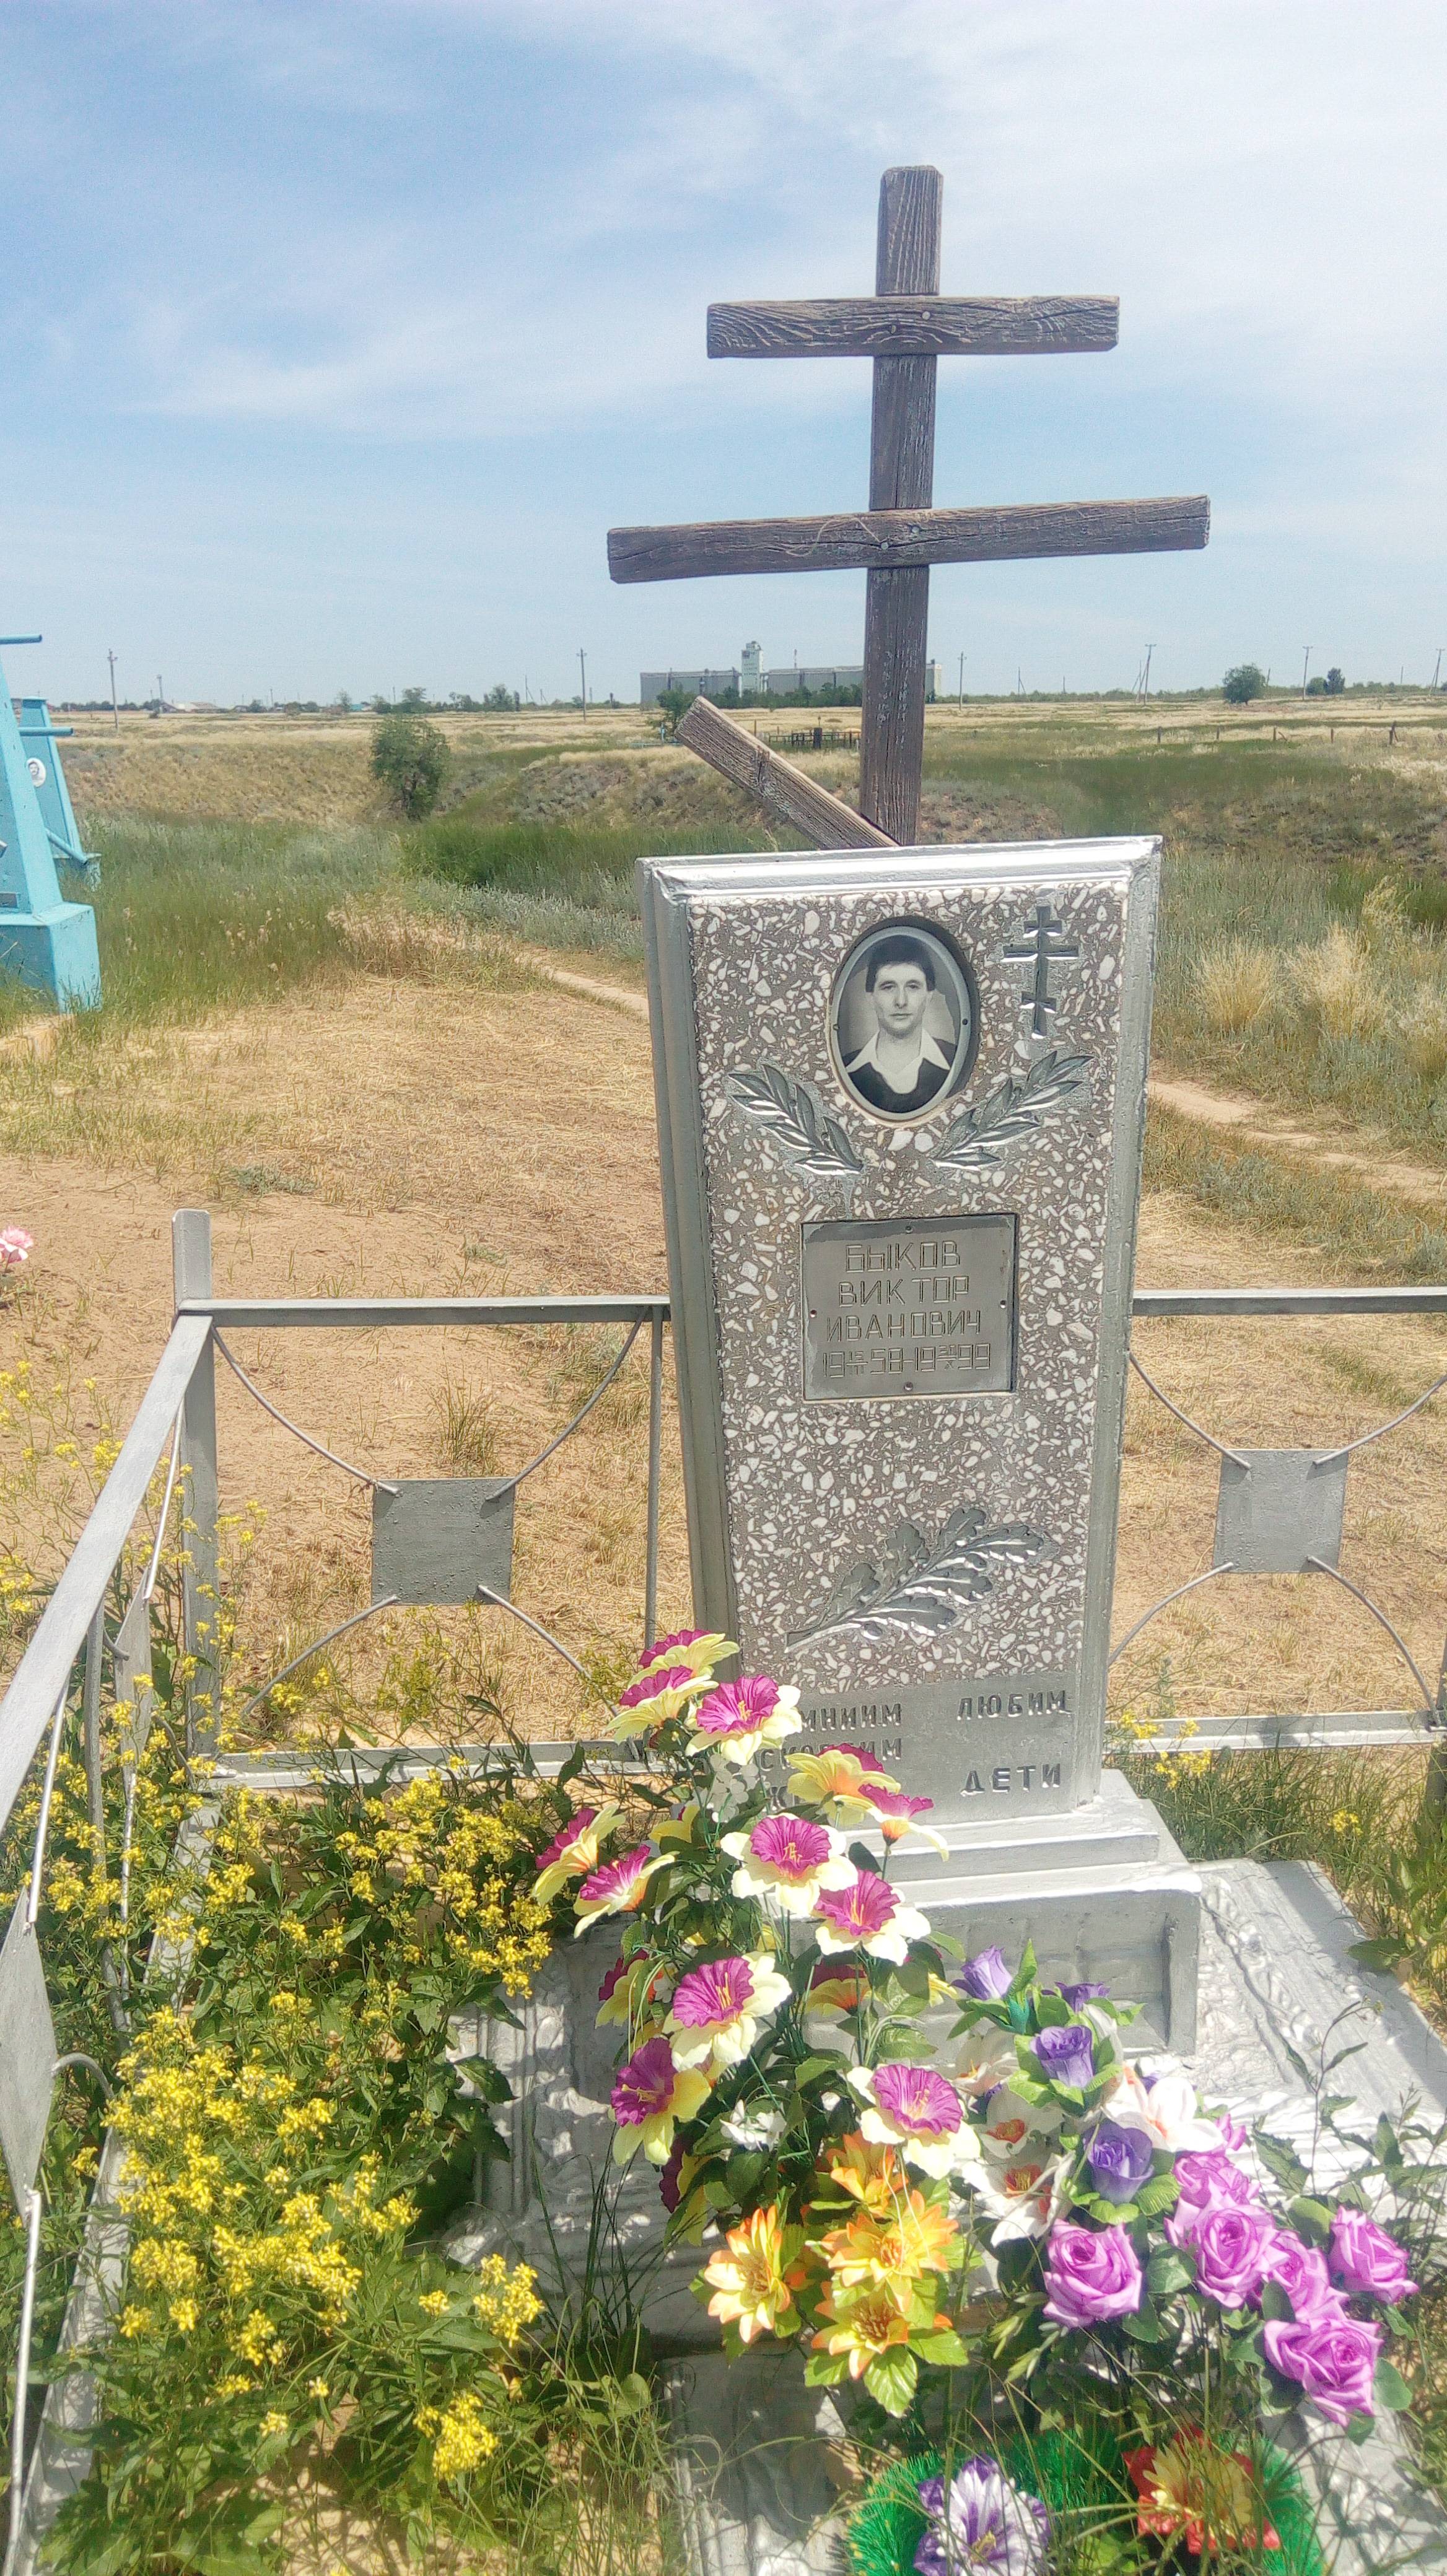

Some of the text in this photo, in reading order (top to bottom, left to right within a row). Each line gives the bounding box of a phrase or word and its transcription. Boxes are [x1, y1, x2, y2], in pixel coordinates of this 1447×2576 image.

[846, 1240, 960, 1273] БЫКОВ
[838, 1275, 969, 1308] ВИКТОР
[827, 1310, 981, 1342] ИВАНОВИЧ
[957, 1690, 1067, 1721] ЛЮБИМ
[960, 1763, 1061, 1797] ДЕТИ
